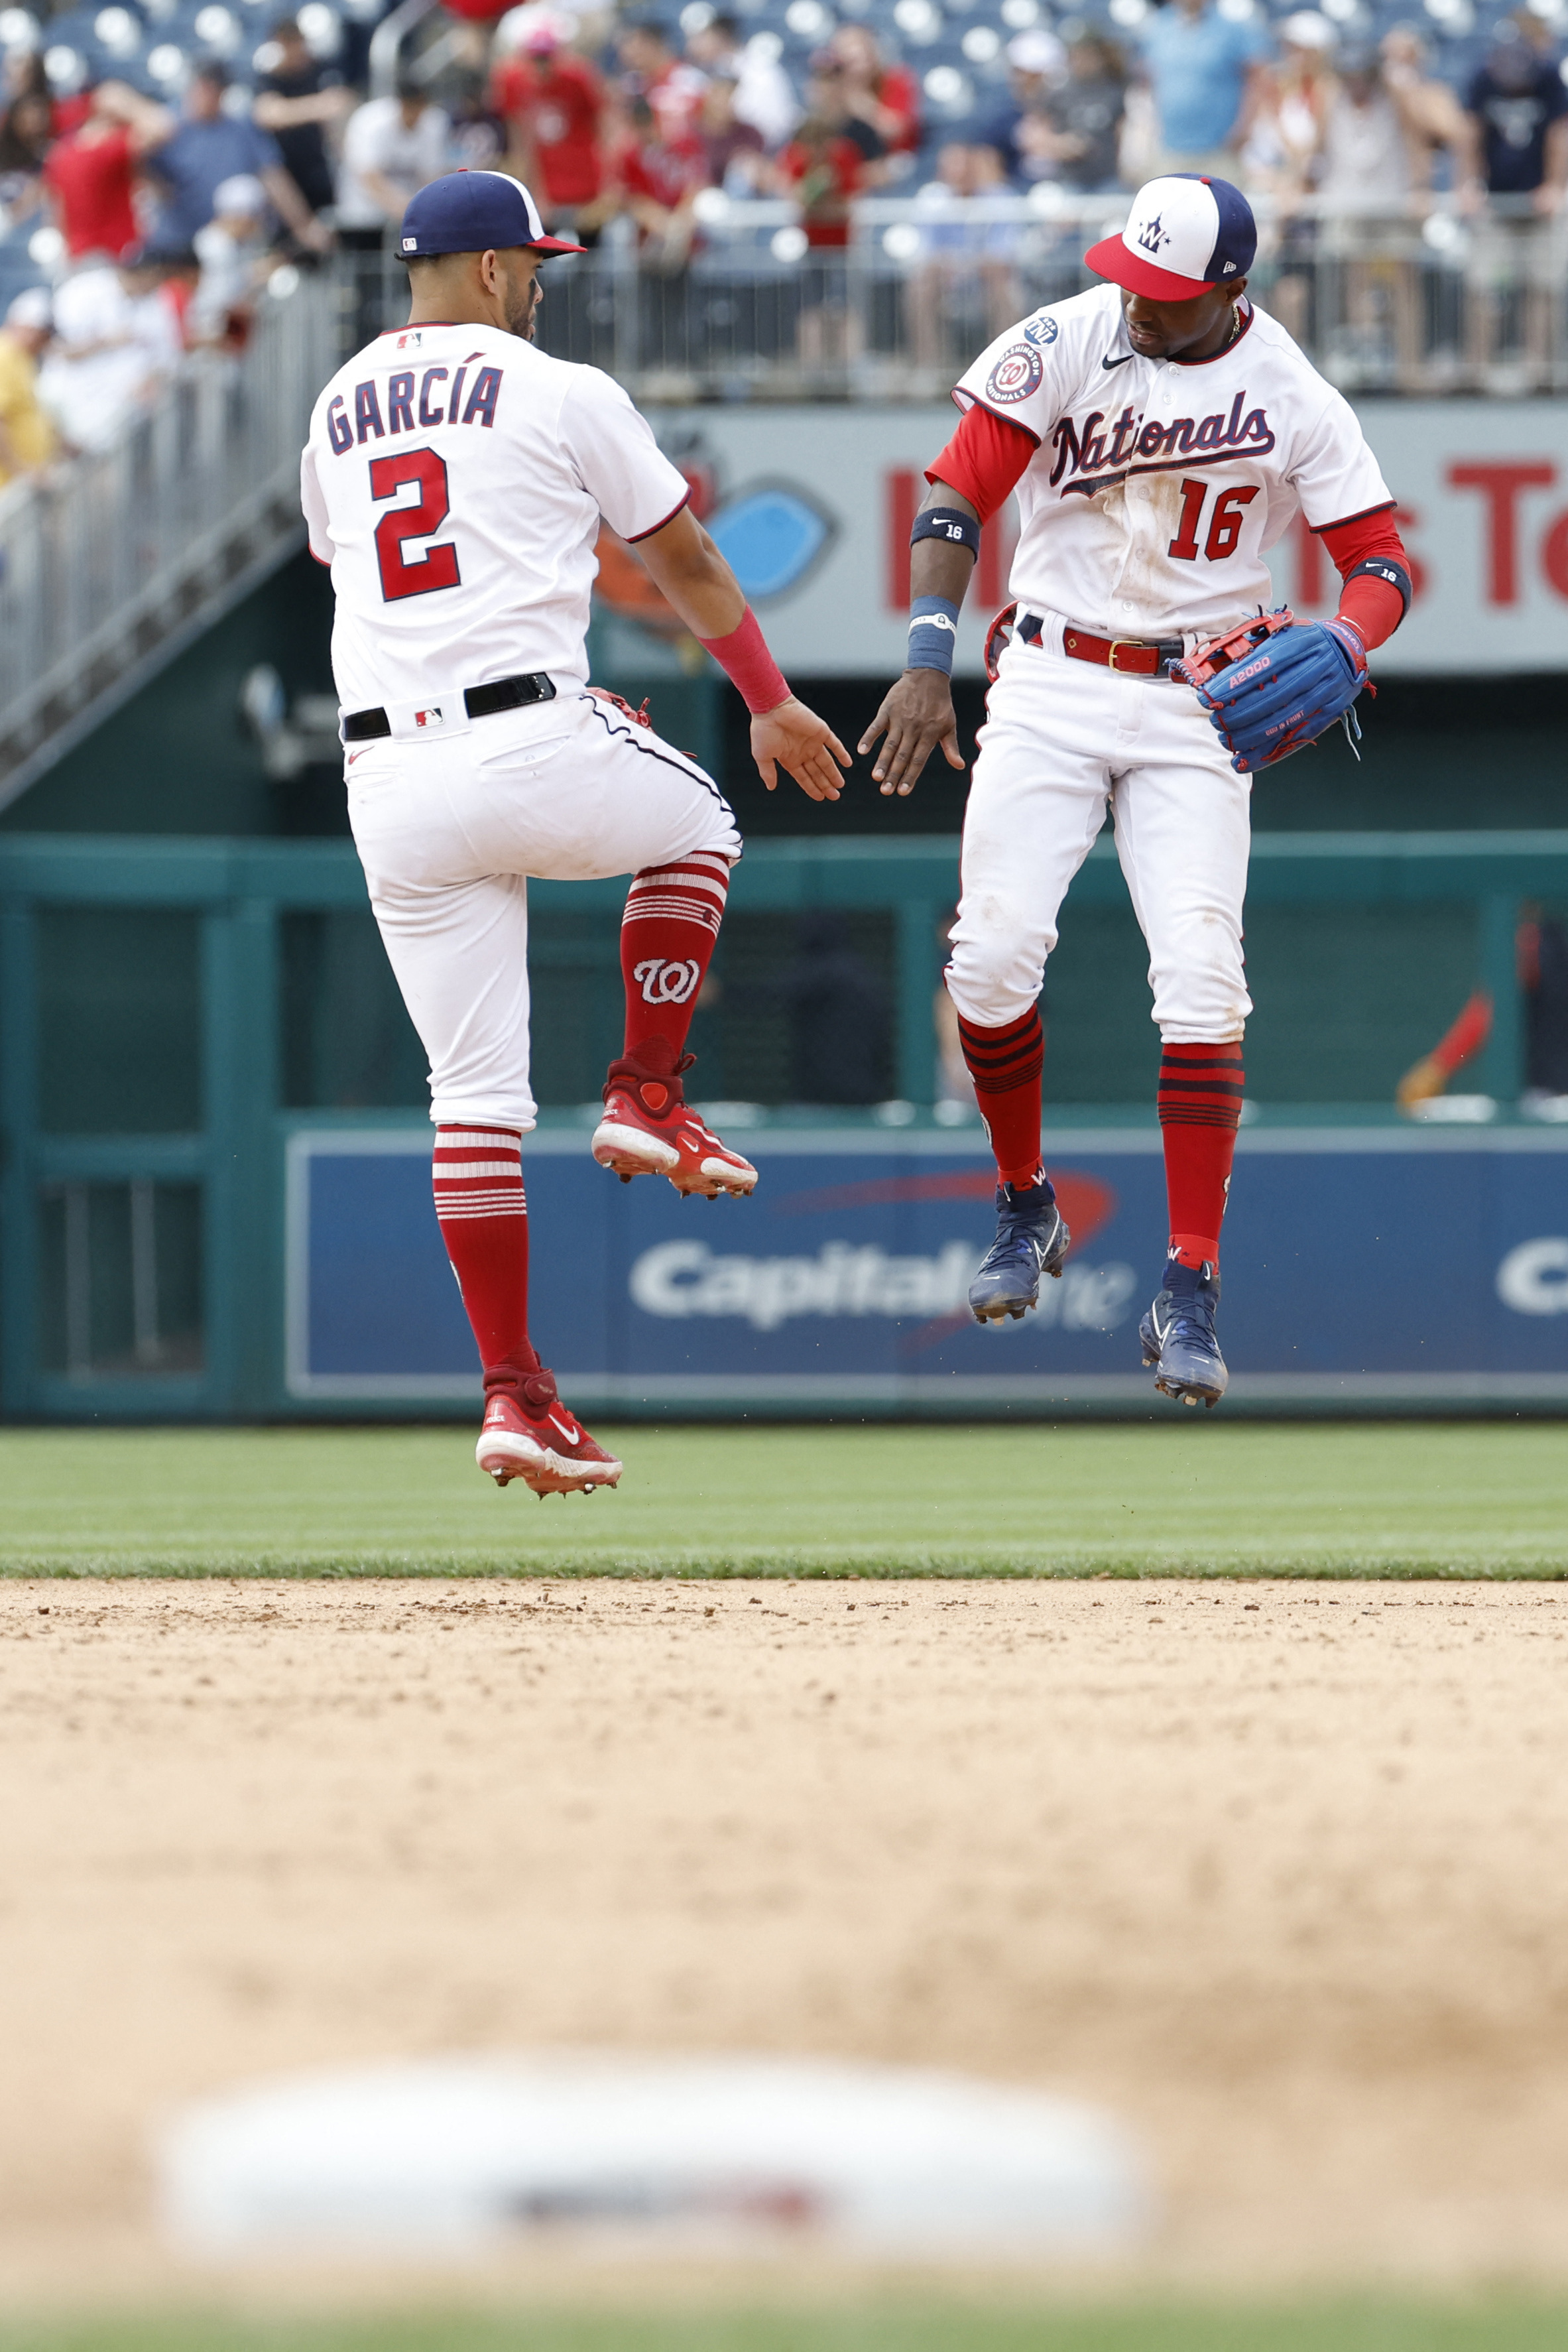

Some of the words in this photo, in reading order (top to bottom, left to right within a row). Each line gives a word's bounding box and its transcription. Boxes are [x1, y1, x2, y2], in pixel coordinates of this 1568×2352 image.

[998, 345, 1040, 376] WASHINGTON
[327, 352, 504, 456] GARCÍA
[987, 379, 1026, 401] NATIONALS
[1050, 390, 1276, 489] Nationals
[368, 446, 461, 603] 2
[946, 524, 963, 540] 16
[1168, 478, 1260, 562] 16
[1381, 568, 1397, 582] 16
[1229, 656, 1271, 689] A2000
[633, 958, 701, 1005] W
[629, 1239, 975, 1332] Capital
